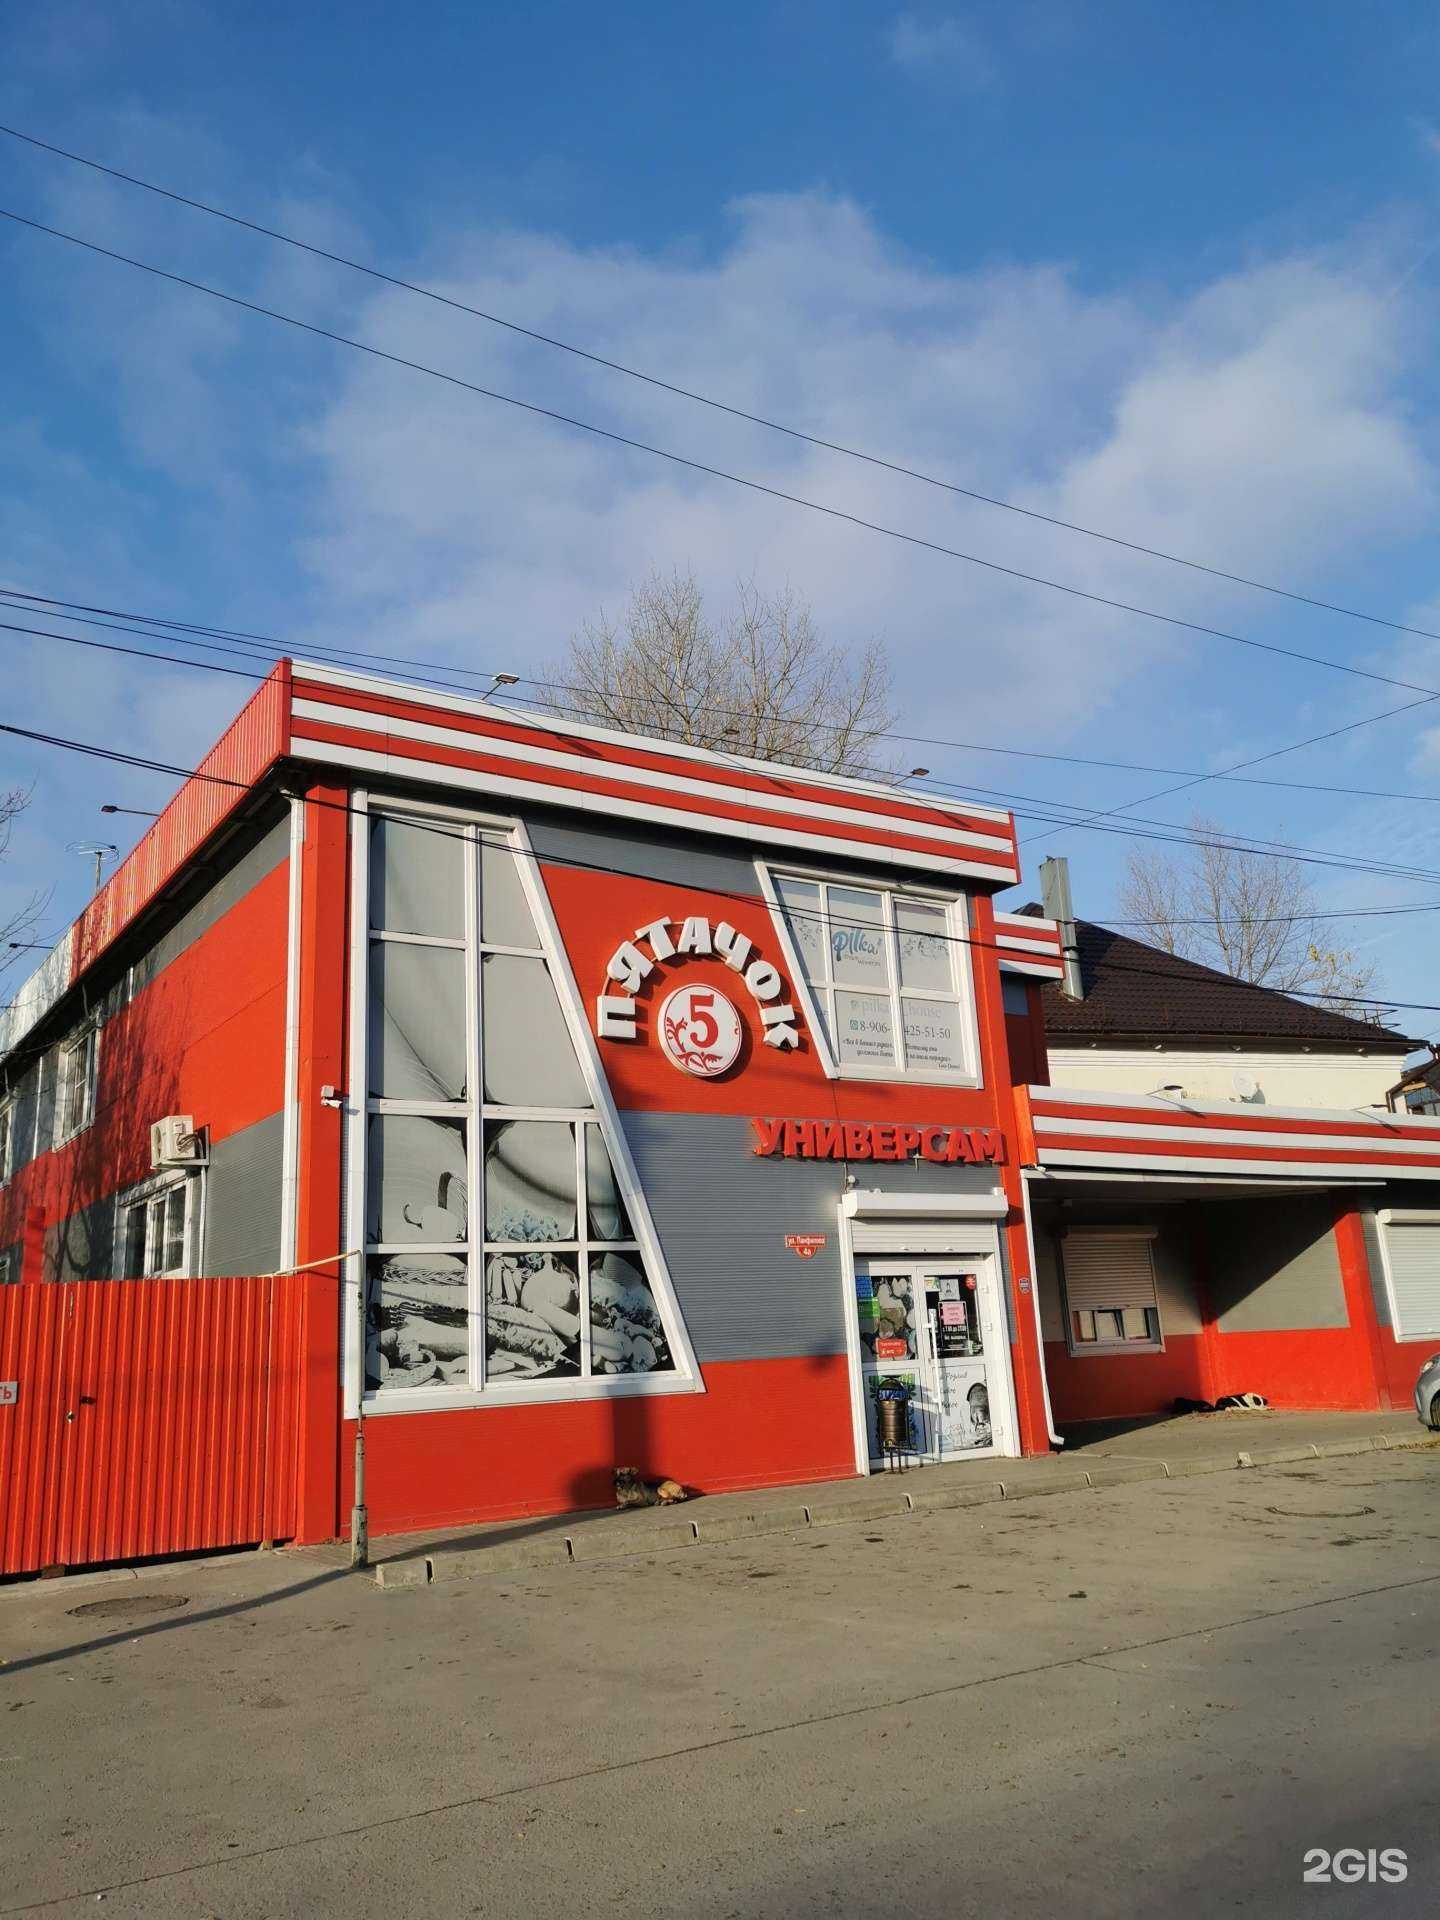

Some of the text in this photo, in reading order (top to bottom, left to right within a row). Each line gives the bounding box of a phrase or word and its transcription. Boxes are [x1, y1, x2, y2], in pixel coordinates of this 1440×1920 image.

[597, 916, 799, 1049] ПЯТАЧОК
[689, 993, 719, 1049] 5
[751, 1118, 1006, 1163] УНИВЕРСАМ
